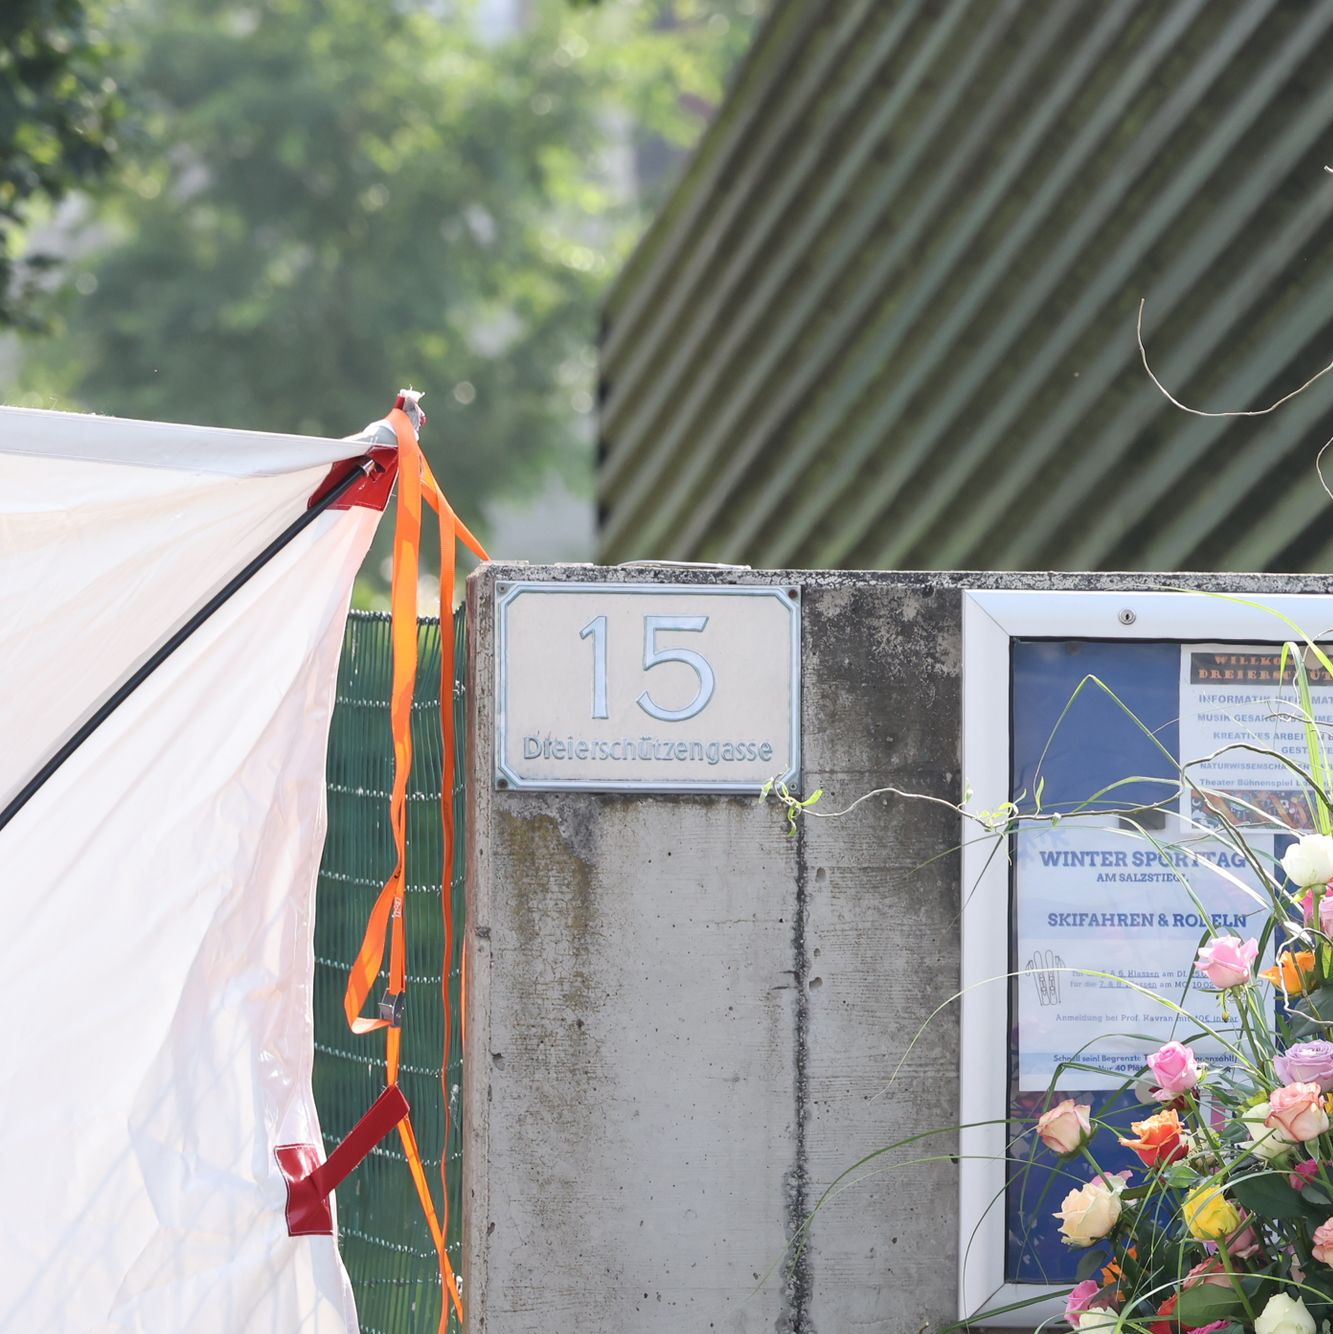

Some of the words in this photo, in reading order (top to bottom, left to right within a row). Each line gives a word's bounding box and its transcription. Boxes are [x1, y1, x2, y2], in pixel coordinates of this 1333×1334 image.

[579, 615, 715, 722] 15
[1272, 732, 1324, 742] ARBEIN
[523, 735, 773, 765] Dreierschützengasse
[1040, 851, 1128, 867] WINTER
[1096, 873, 1116, 883] AM
[1047, 913, 1154, 928] SKIFAHREN
[1158, 913, 1169, 928] &
